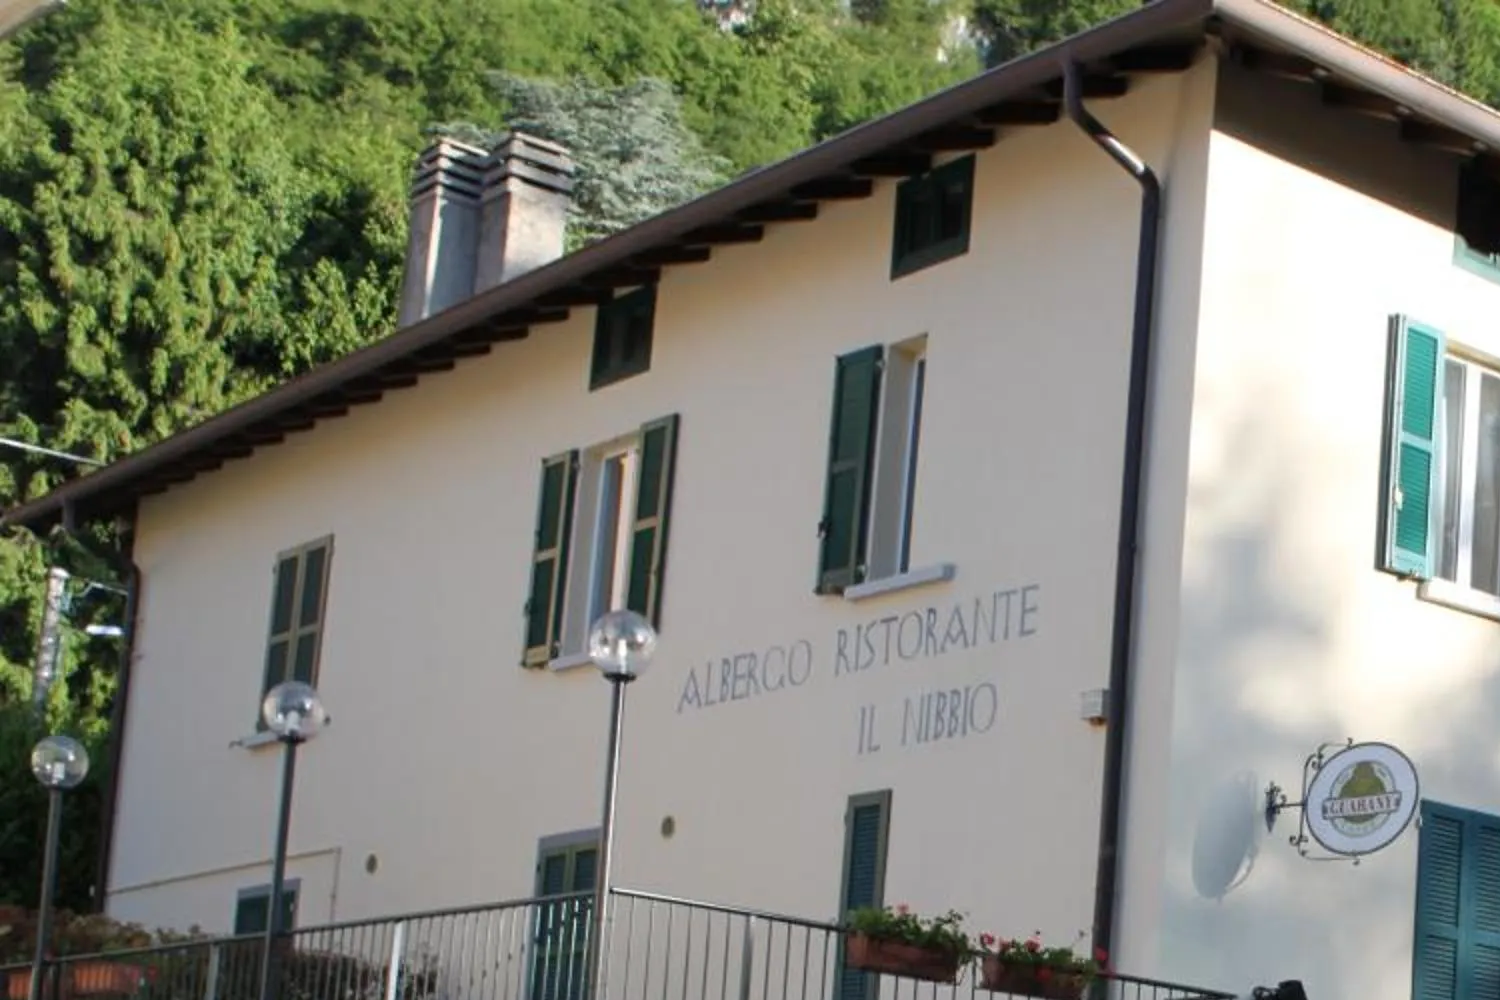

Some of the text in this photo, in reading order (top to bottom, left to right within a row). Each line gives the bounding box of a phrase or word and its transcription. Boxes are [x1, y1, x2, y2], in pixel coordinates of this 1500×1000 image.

[676, 584, 1040, 714] ALBERGO RISTORANTE
[857, 682, 998, 756] IL NIBBIO
